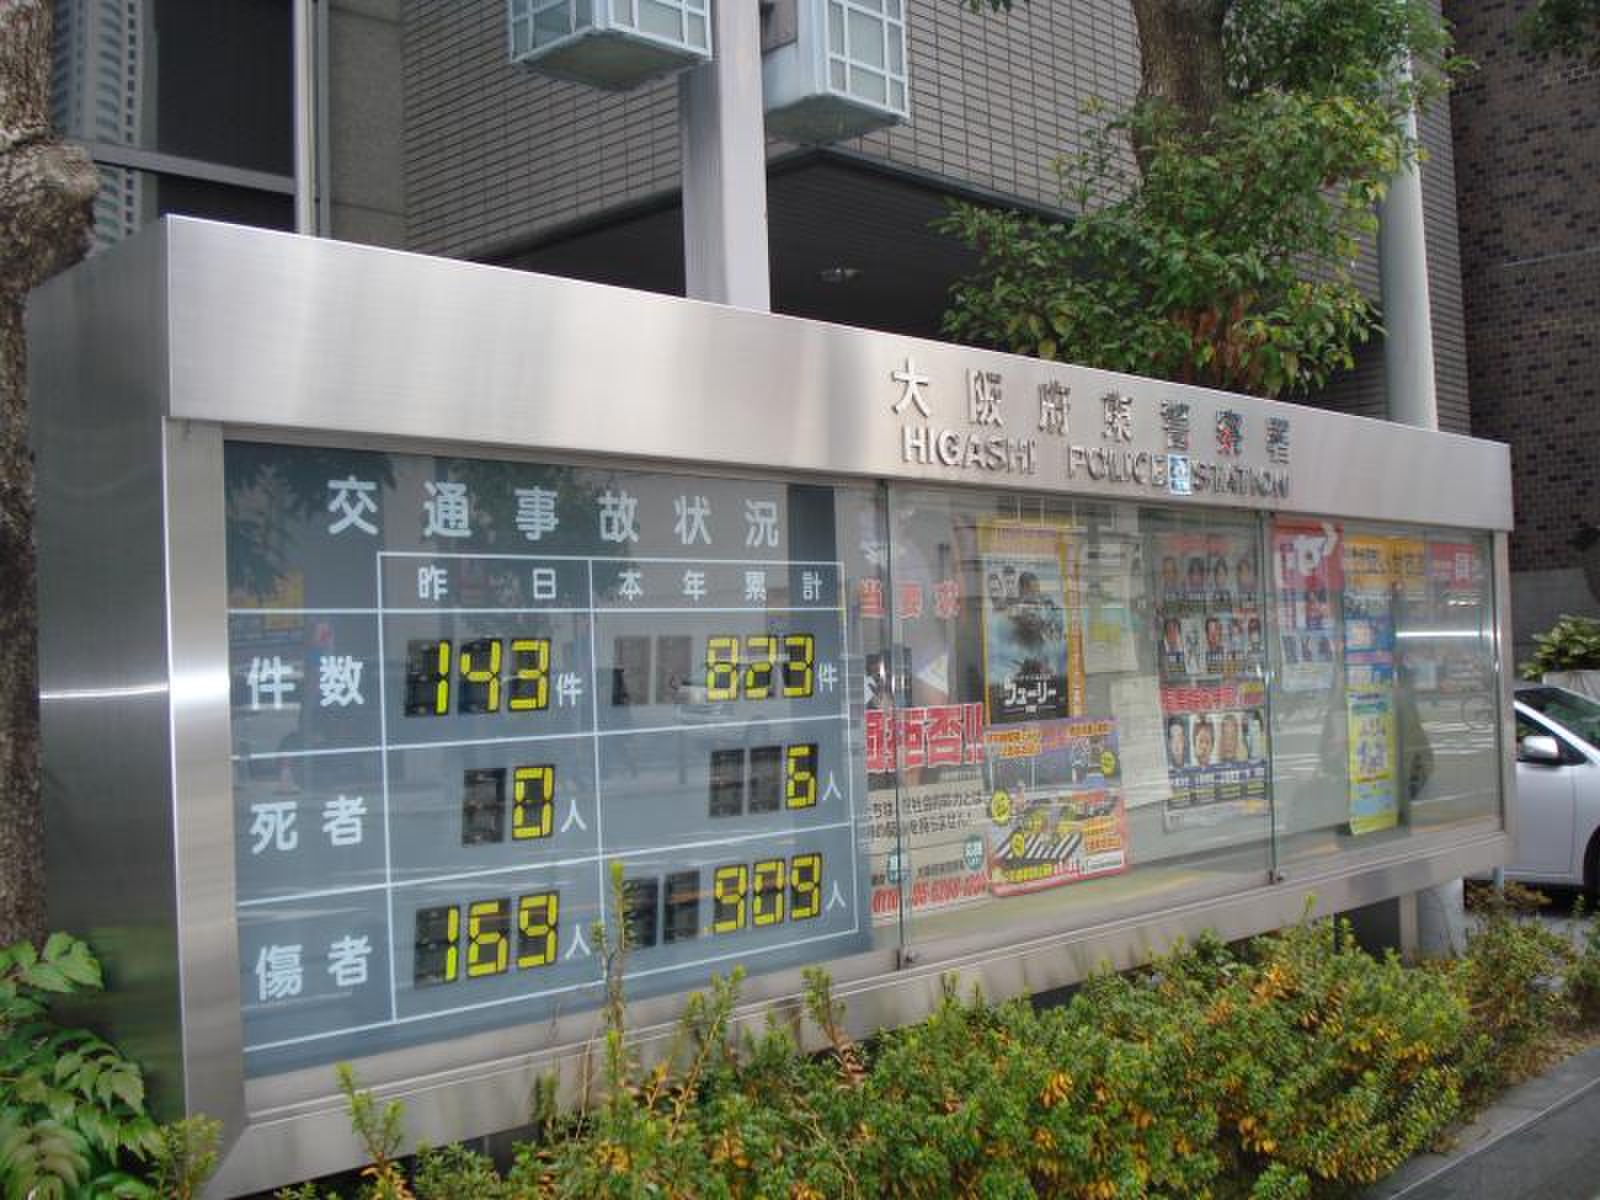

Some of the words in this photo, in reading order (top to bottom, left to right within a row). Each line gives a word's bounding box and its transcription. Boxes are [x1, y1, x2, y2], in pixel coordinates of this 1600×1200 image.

[891, 356, 1290, 465] 大阪府東警察署
[901, 425, 1036, 475] HIGASHI
[1067, 446, 1167, 487] POLICE
[1192, 462, 1290, 499] STATION
[327, 475, 780, 548] 交通事故状況
[417, 564, 557, 600] 昨日
[617, 568, 823, 602] 本年累計
[247, 655, 365, 711] 件数
[432, 636, 551, 717] 143
[706, 633, 816, 702] 823
[511, 764, 555, 841] 0
[561, 799, 588, 833] 人
[785, 743, 818, 811] 6
[823, 770, 843, 801] 人
[250, 795, 367, 855] 死者
[713, 852, 823, 935] 909
[826, 880, 847, 912] 人
[255, 934, 373, 1000] 傷者
[444, 890, 559, 983] 169
[565, 925, 591, 960] 人
